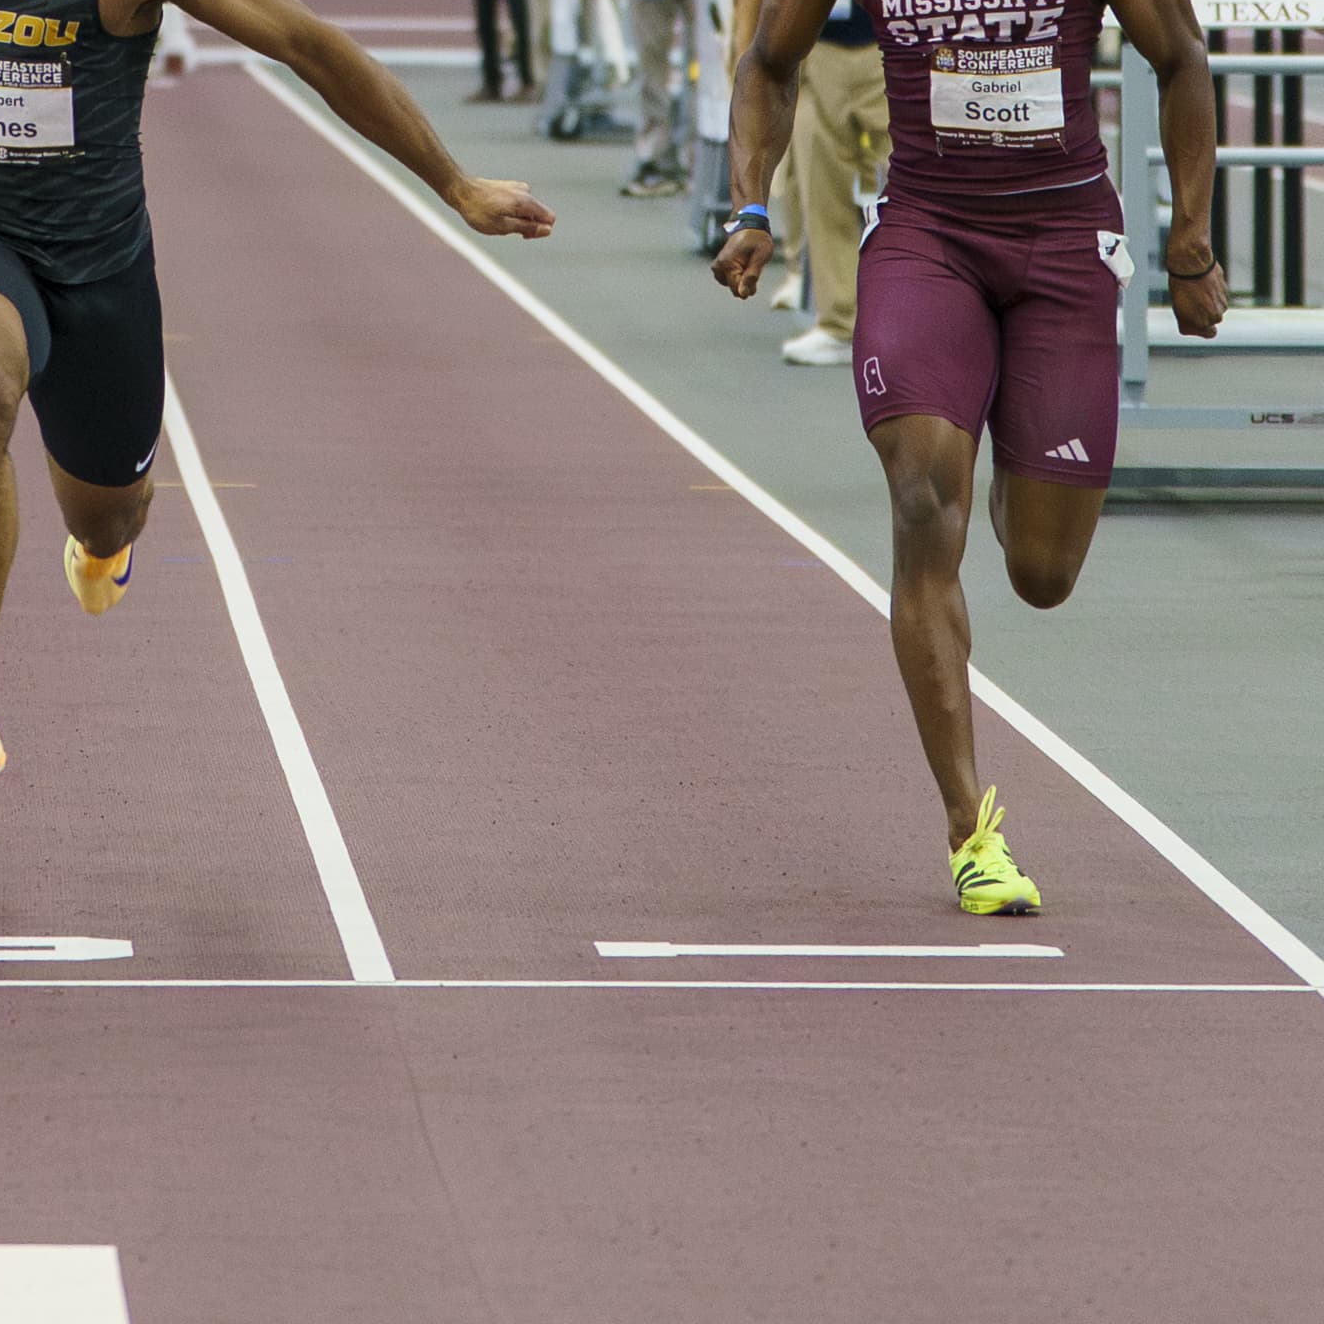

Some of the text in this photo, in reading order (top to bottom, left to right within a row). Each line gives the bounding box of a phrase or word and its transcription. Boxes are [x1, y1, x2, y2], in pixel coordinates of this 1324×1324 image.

[1207, 2, 1311, 21] TEXAS
[887, 7, 1065, 46] STATE
[958, 46, 1053, 60] SOUTHEASTERN
[958, 56, 1053, 69] CONFERENCE
[972, 81, 1021, 93] Gabriel
[965, 102, 1030, 122] Scott
[1250, 413, 1295, 424] UCS
[593, 941, 1065, 957] 1
